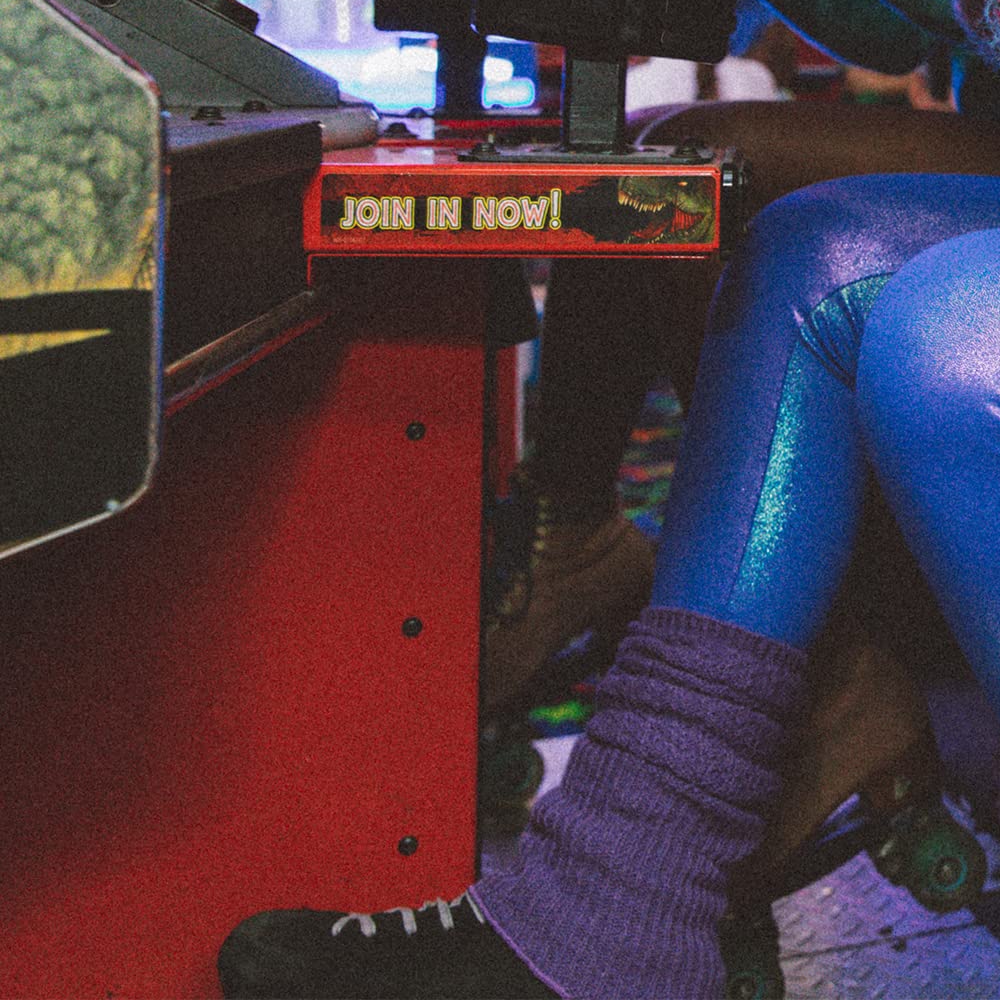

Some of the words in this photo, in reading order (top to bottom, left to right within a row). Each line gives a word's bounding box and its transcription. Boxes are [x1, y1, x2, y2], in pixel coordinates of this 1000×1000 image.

[340, 195, 414, 231] JOIN
[425, 196, 460, 231] IN
[472, 188, 562, 231] NOW!
